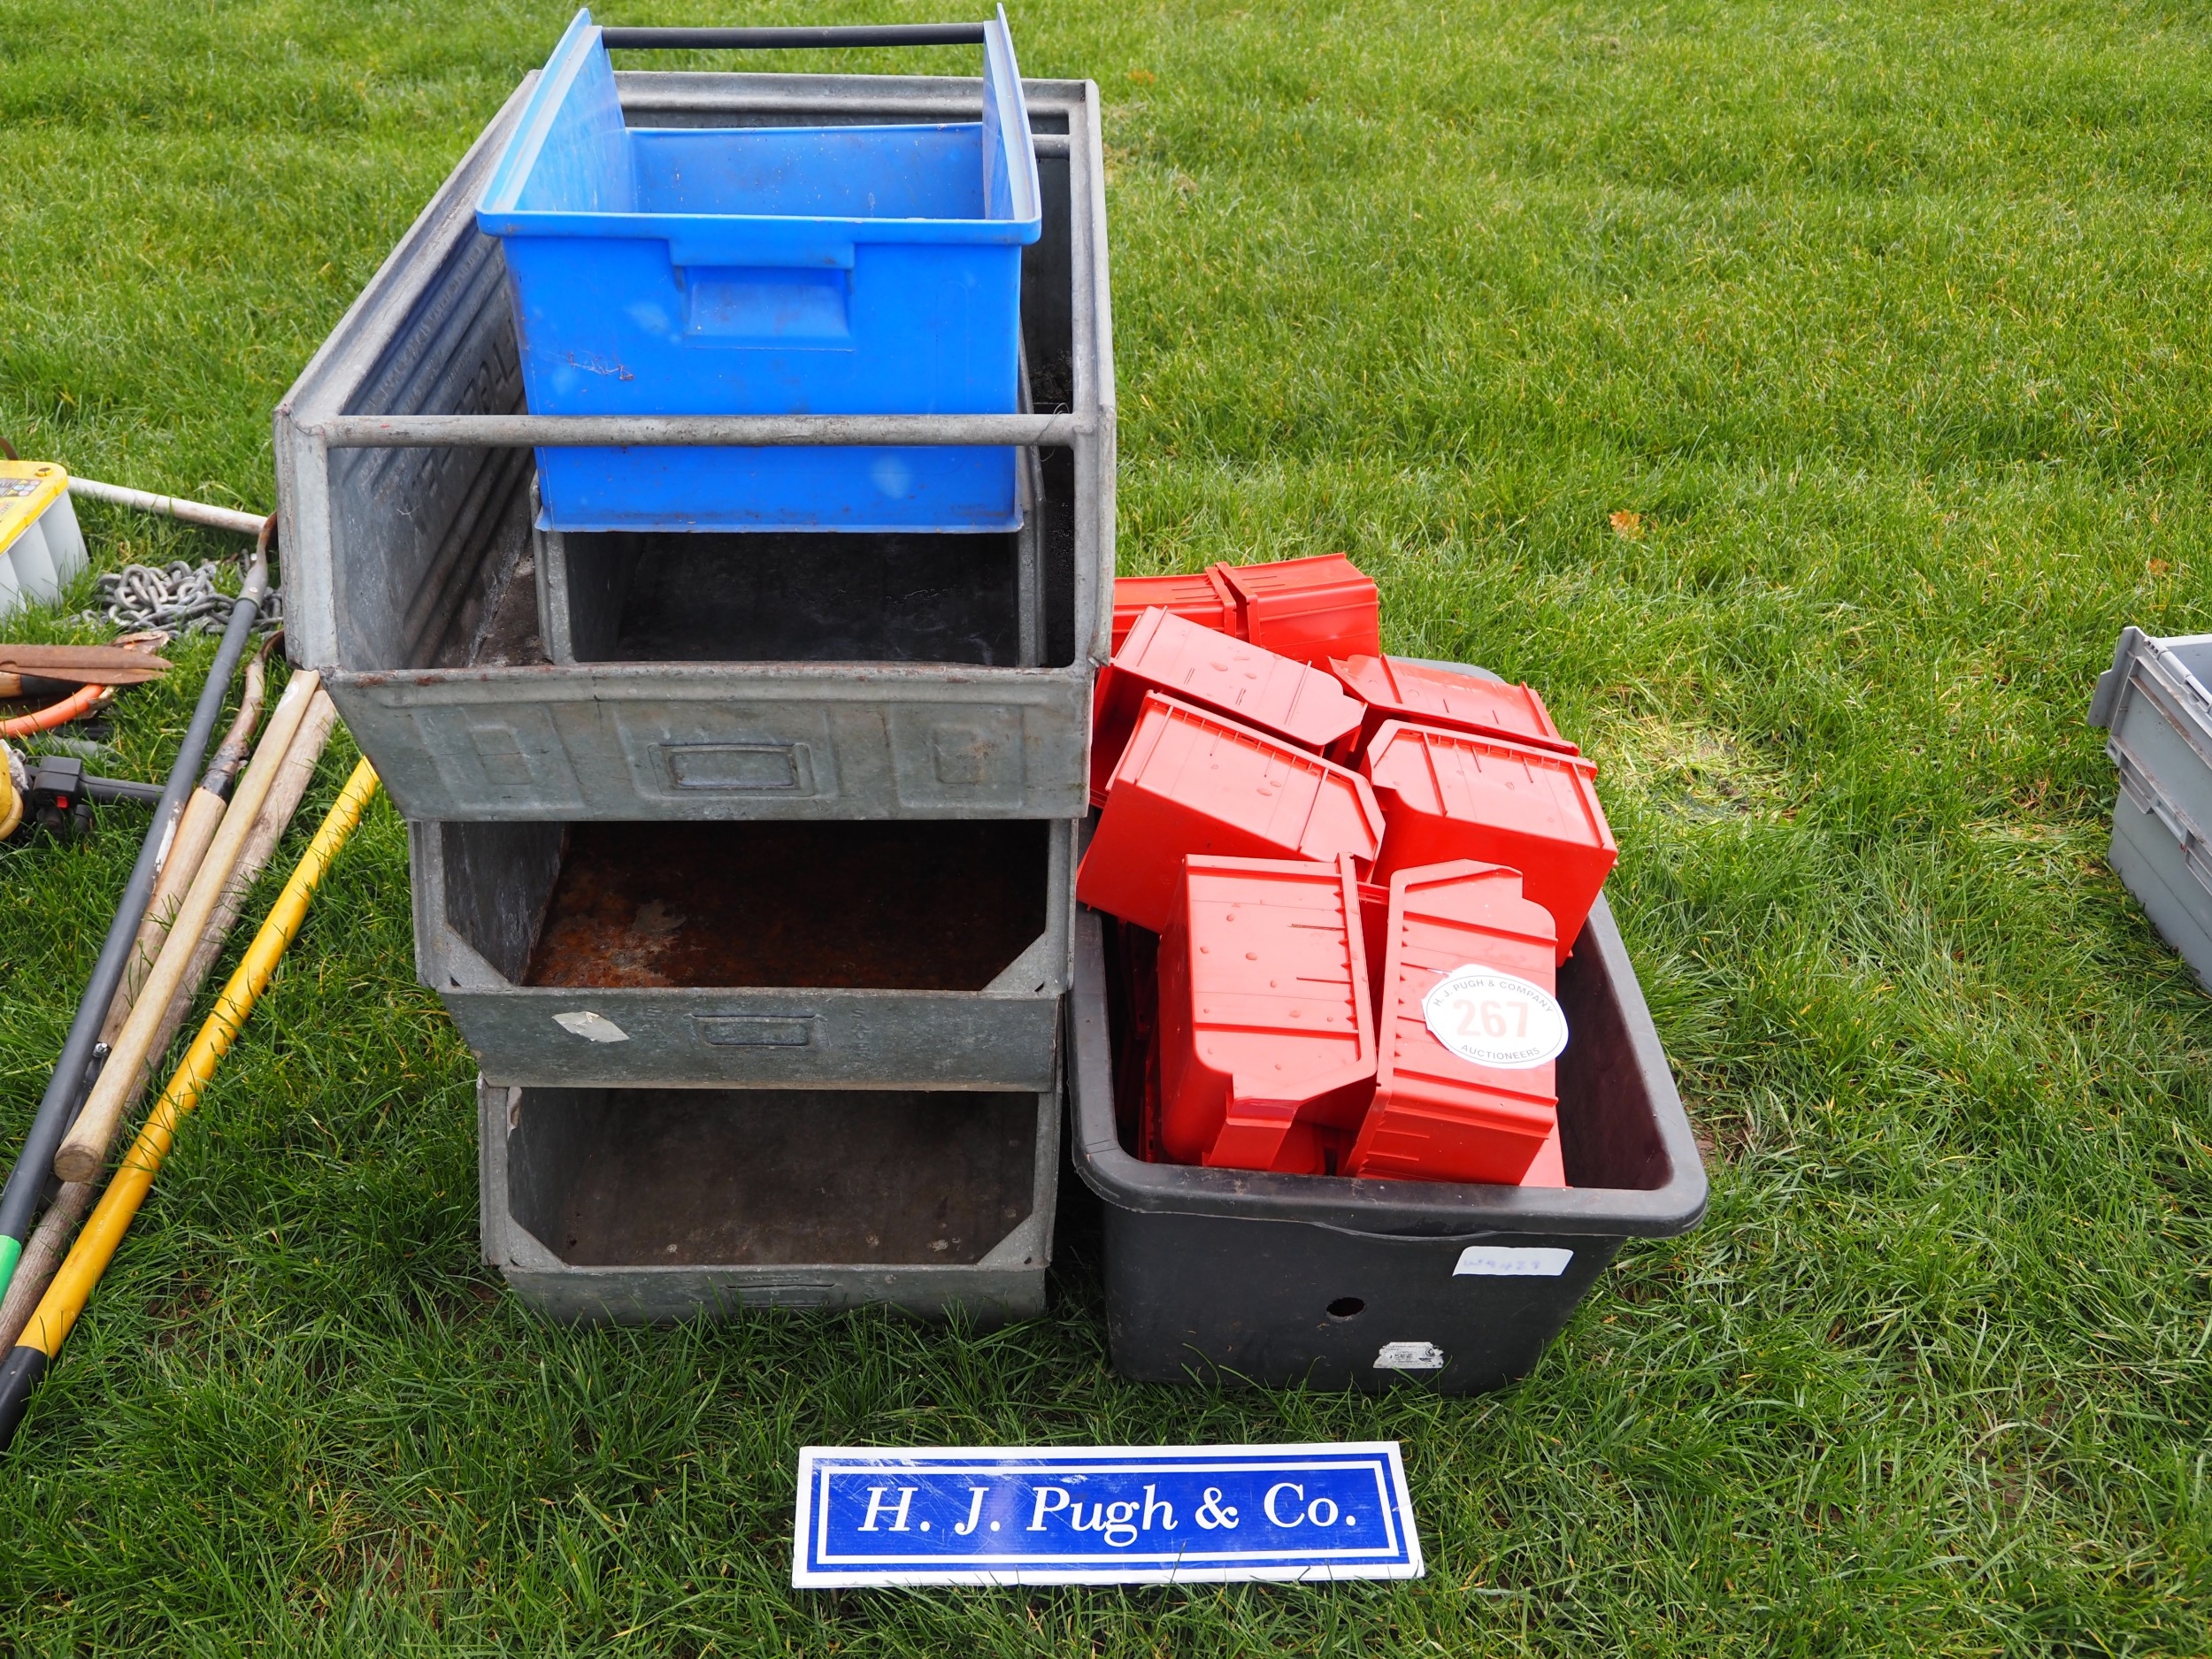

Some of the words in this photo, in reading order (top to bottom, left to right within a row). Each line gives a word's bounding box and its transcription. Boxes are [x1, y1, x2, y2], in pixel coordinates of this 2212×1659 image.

[1433, 998, 1444, 1007] H.
[1444, 987, 1453, 997] J.
[1454, 979, 1484, 991] PUGH
[1500, 982, 1554, 1012] COMPANY
[1453, 1000, 1529, 1038] 267
[1462, 1045, 1540, 1060] AUCTIONEERS
[857, 1486, 931, 1532] H.
[954, 1486, 1002, 1536] J.
[1025, 1483, 1179, 1548] Pugh
[1194, 1486, 1240, 1530] &
[1263, 1482, 1357, 1528] Co.
